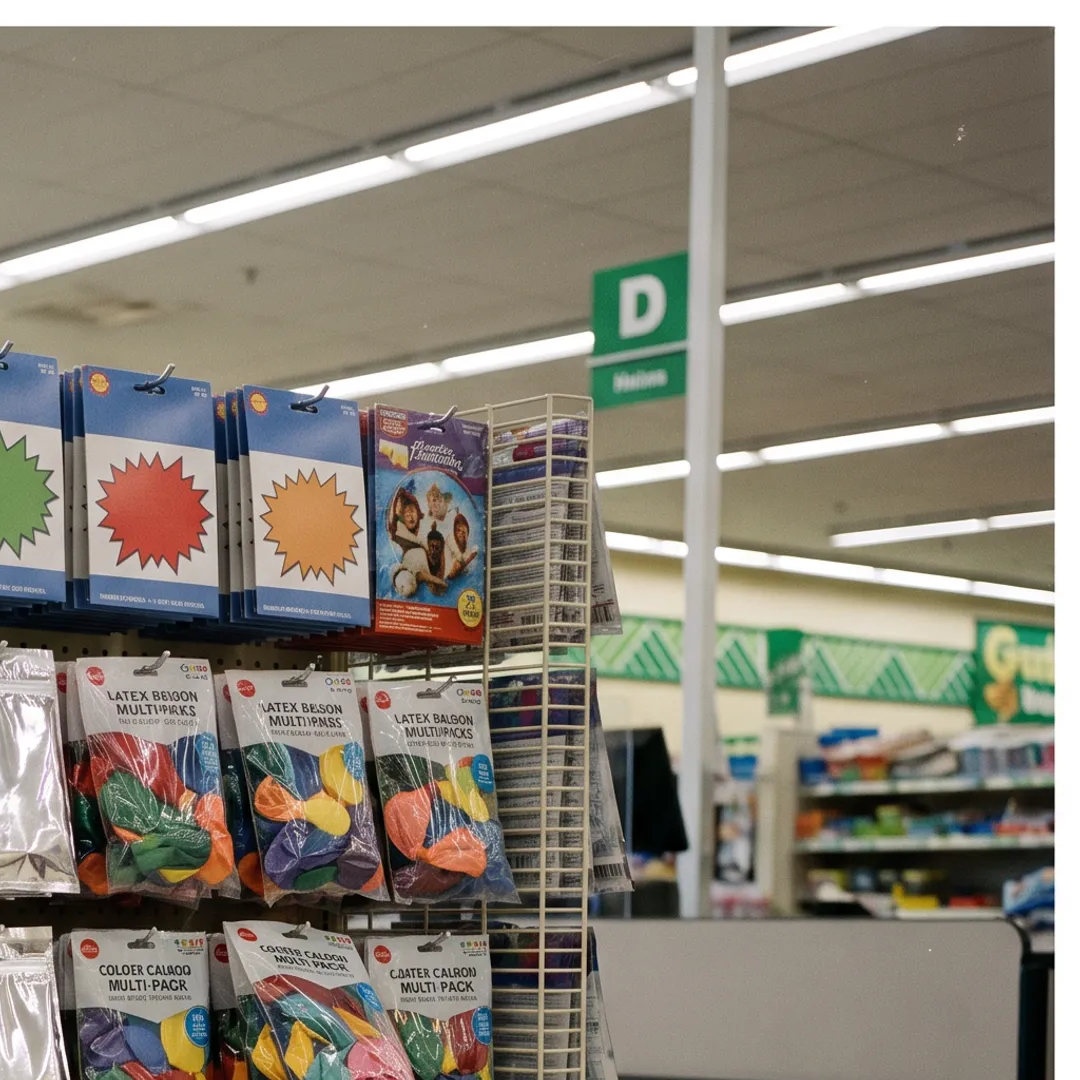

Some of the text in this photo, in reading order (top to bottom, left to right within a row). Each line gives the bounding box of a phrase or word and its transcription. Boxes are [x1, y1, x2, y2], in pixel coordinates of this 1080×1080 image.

[619, 274, 667, 340] D
[107, 690, 149, 702] LATEX
[259, 702, 299, 713] LATEX
[394, 713, 431, 724] LATEX
